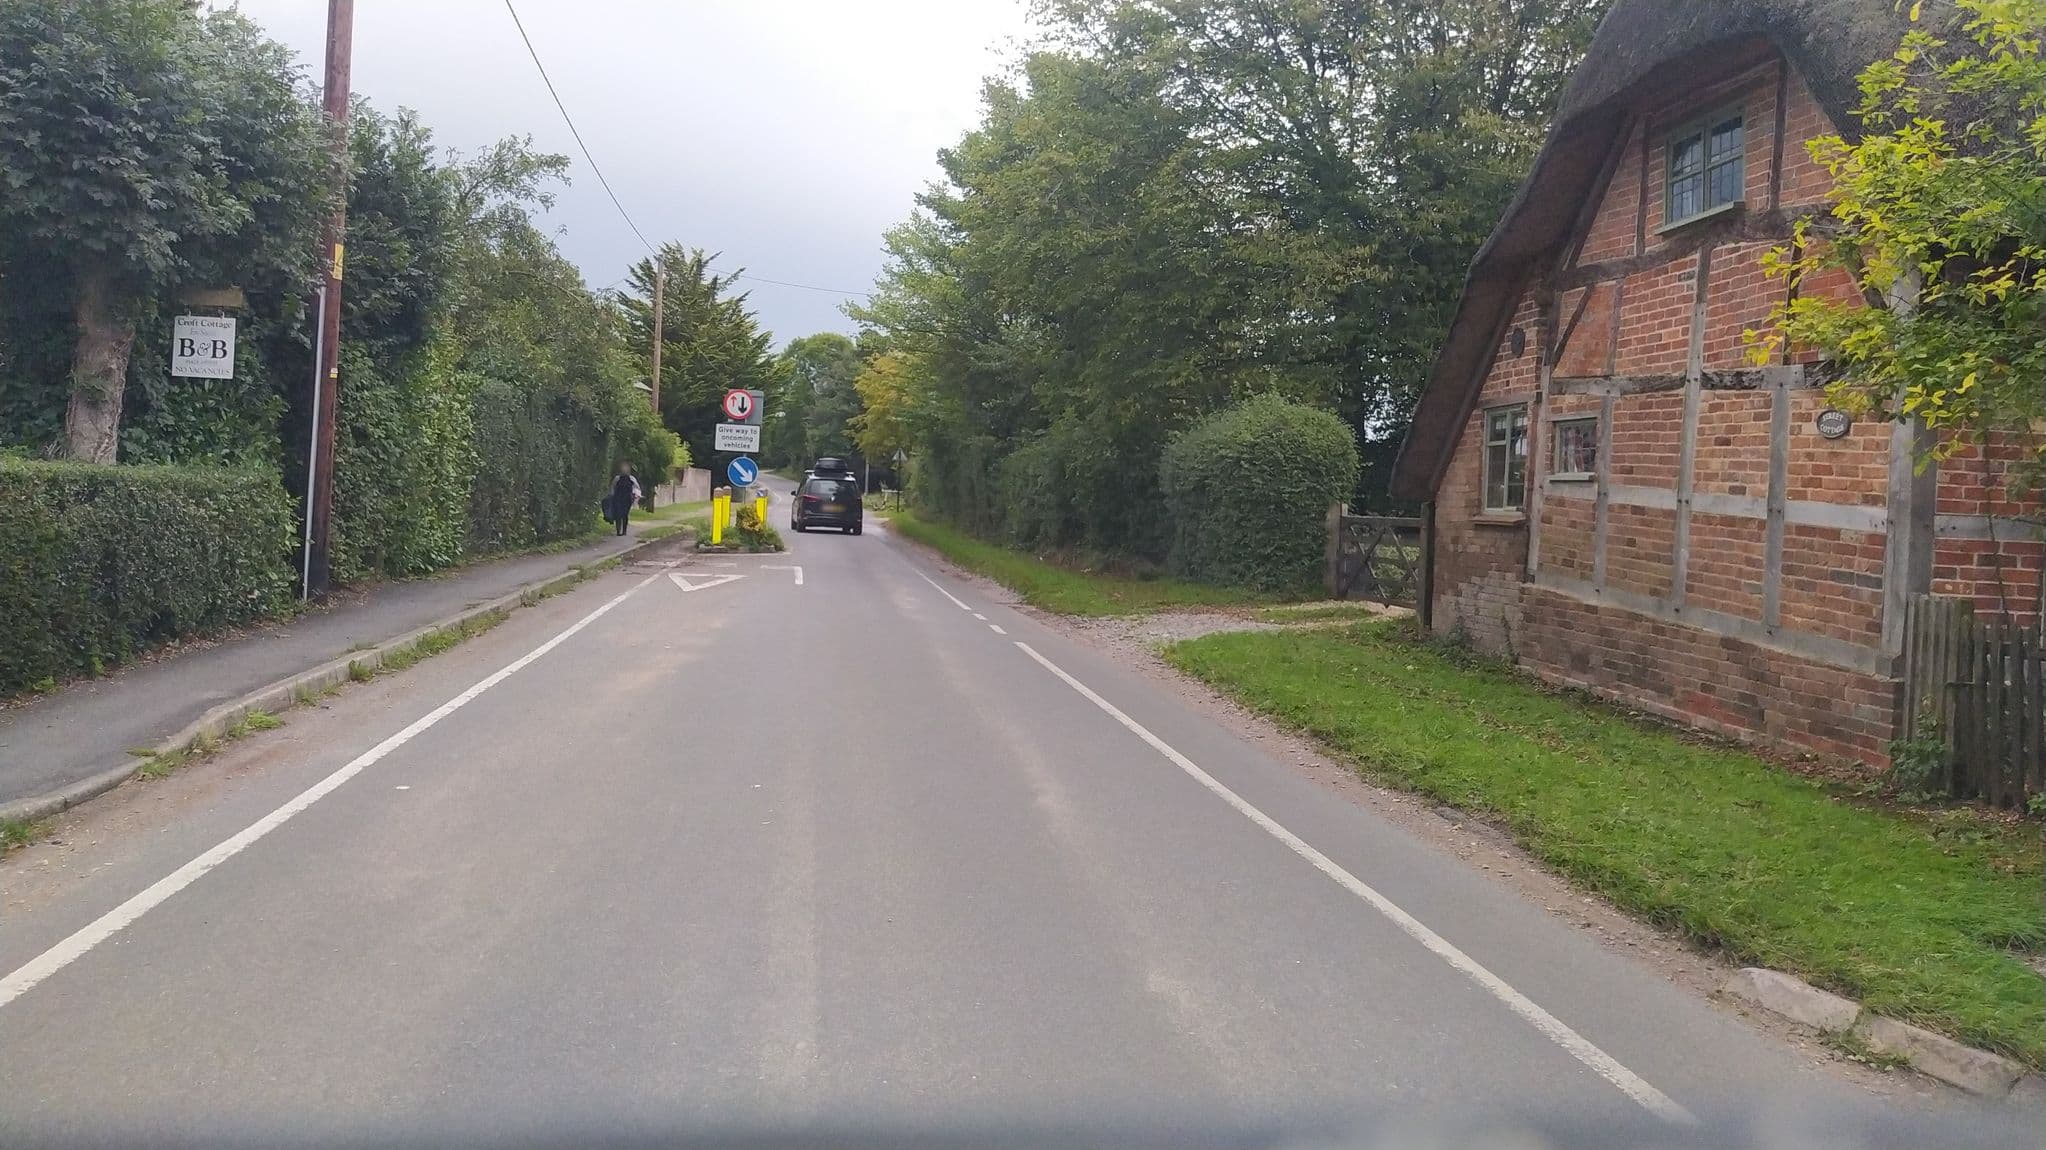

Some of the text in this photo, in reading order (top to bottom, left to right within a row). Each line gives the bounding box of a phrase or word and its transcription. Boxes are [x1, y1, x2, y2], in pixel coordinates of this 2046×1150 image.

[177, 318, 233, 329] Croft Cottage
[179, 338, 227, 359] B&B
[750, 427, 758, 435] to
